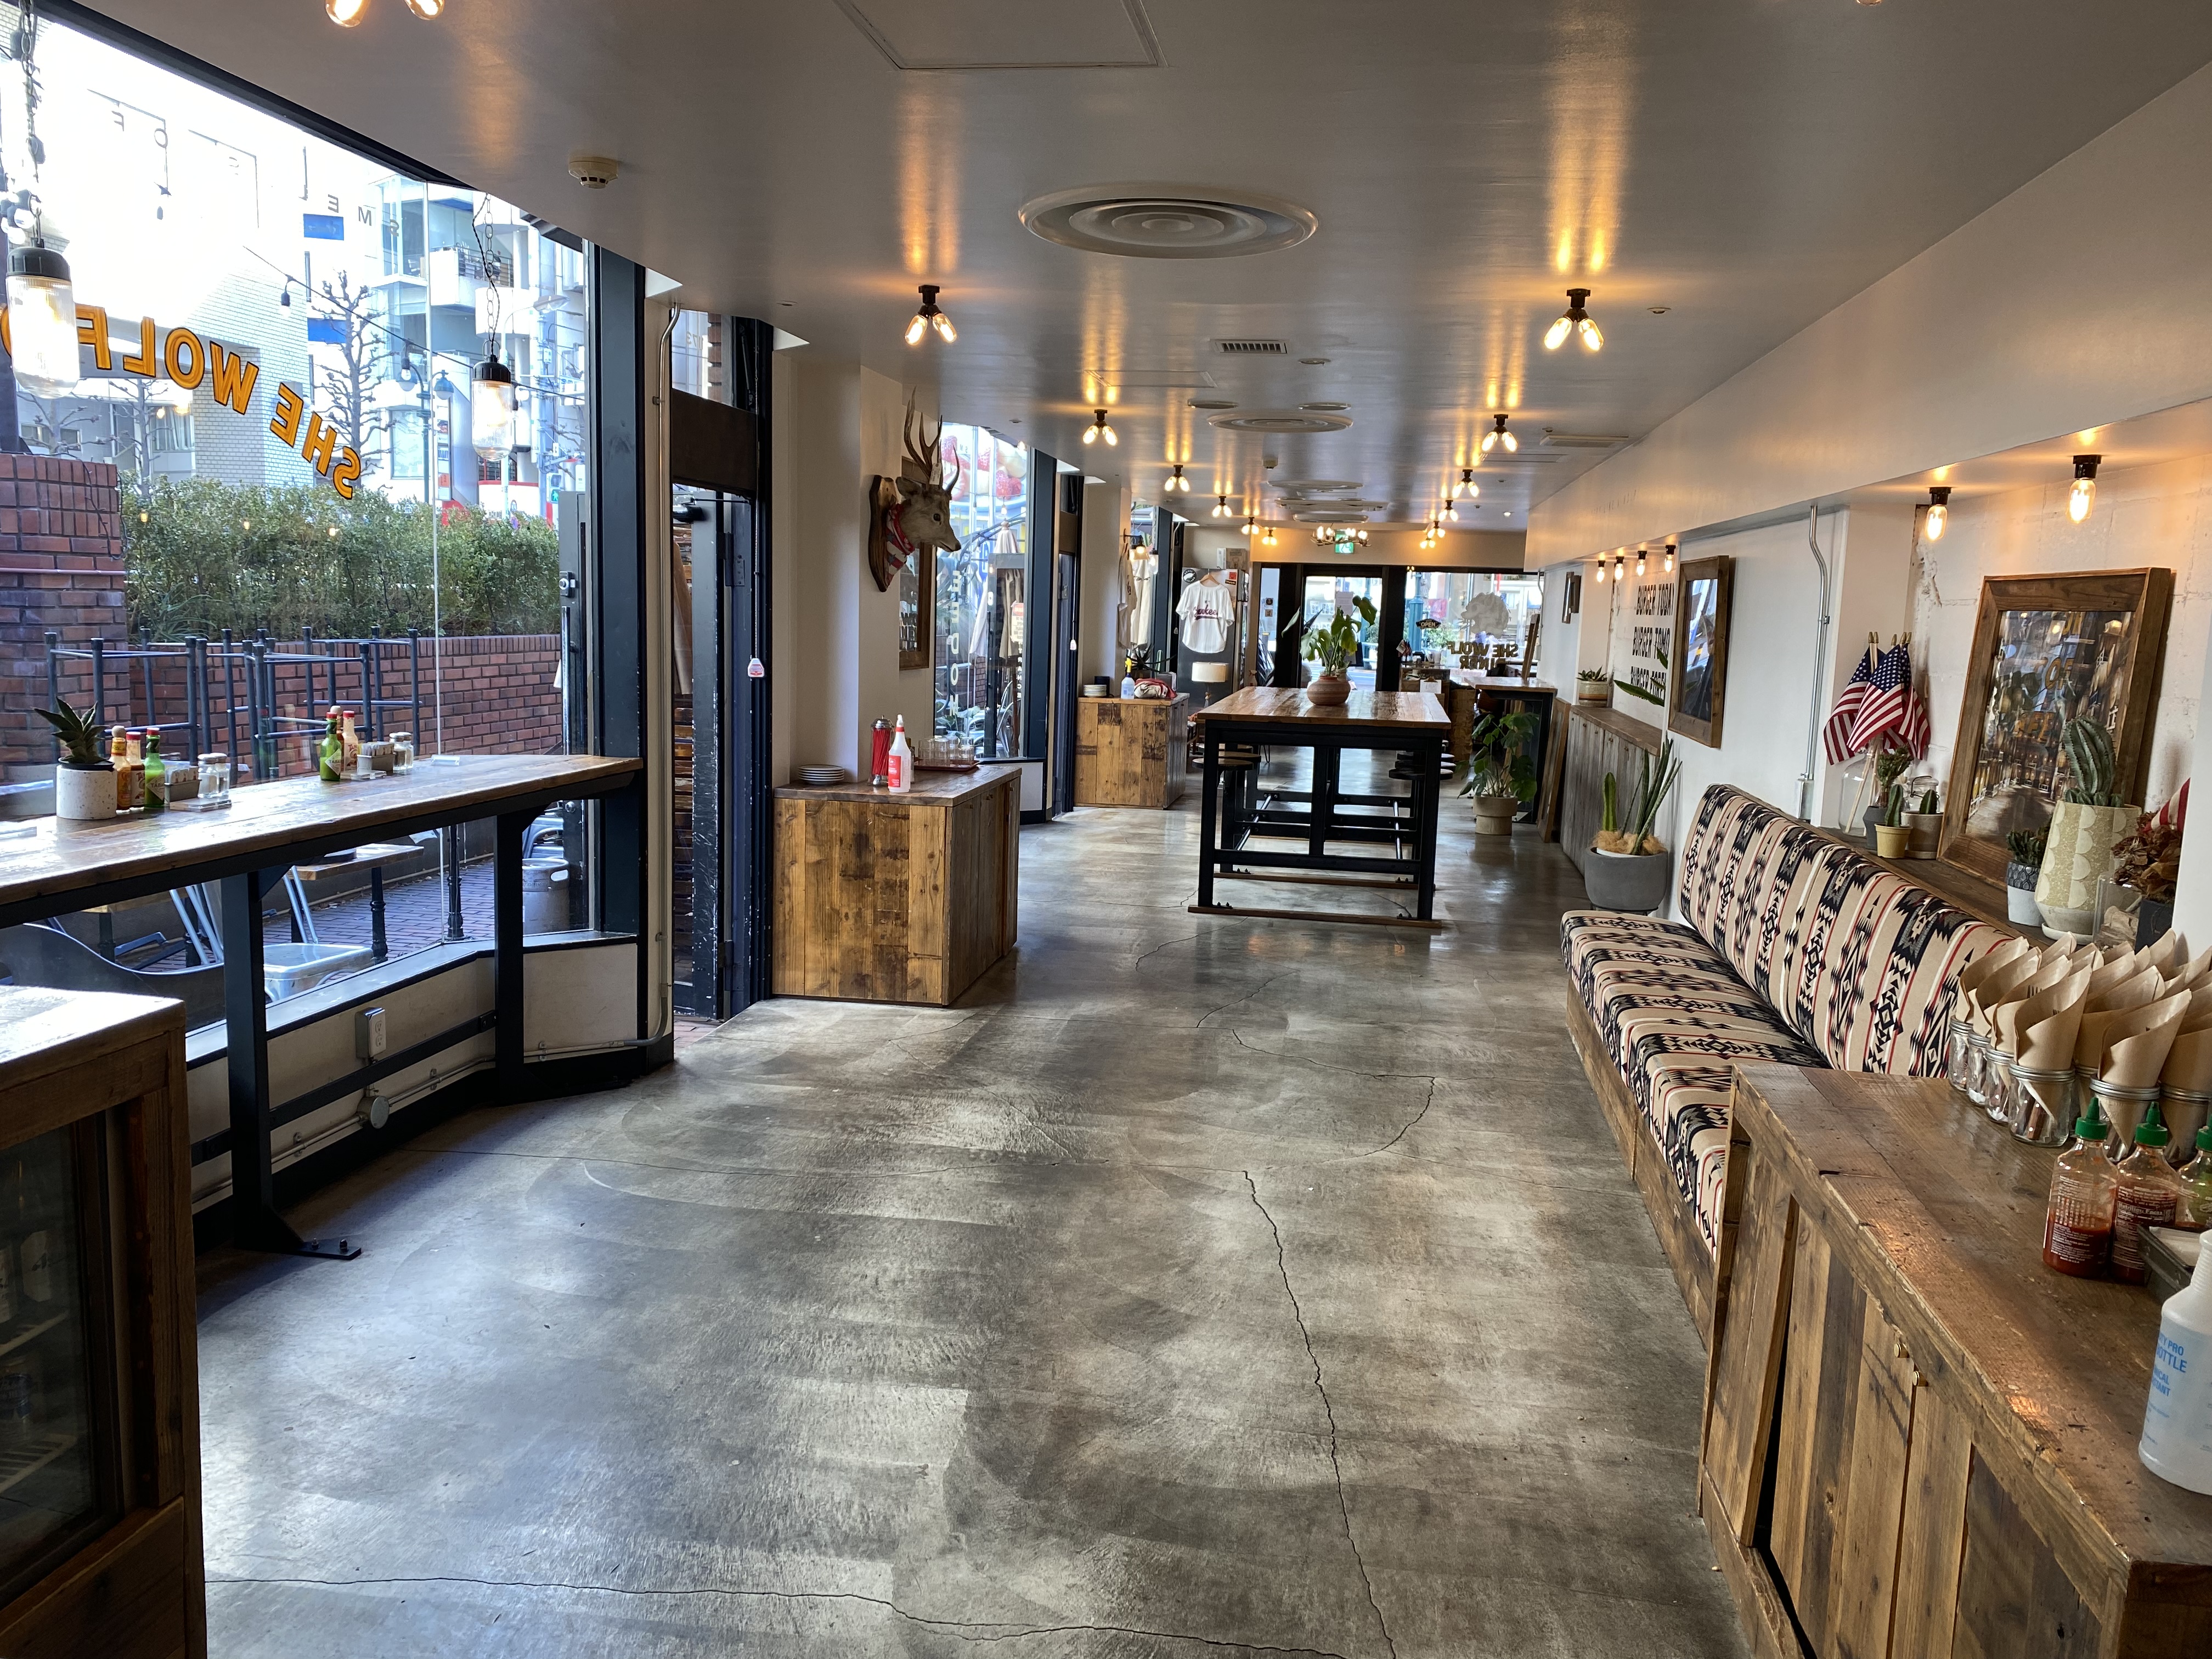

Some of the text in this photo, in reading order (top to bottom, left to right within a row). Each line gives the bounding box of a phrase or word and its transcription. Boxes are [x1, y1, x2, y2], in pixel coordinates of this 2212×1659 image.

[1636, 584, 1656, 616] BURGER
[1632, 627, 1653, 658] BURGER
[2168, 1340, 2184, 1356] PRO
